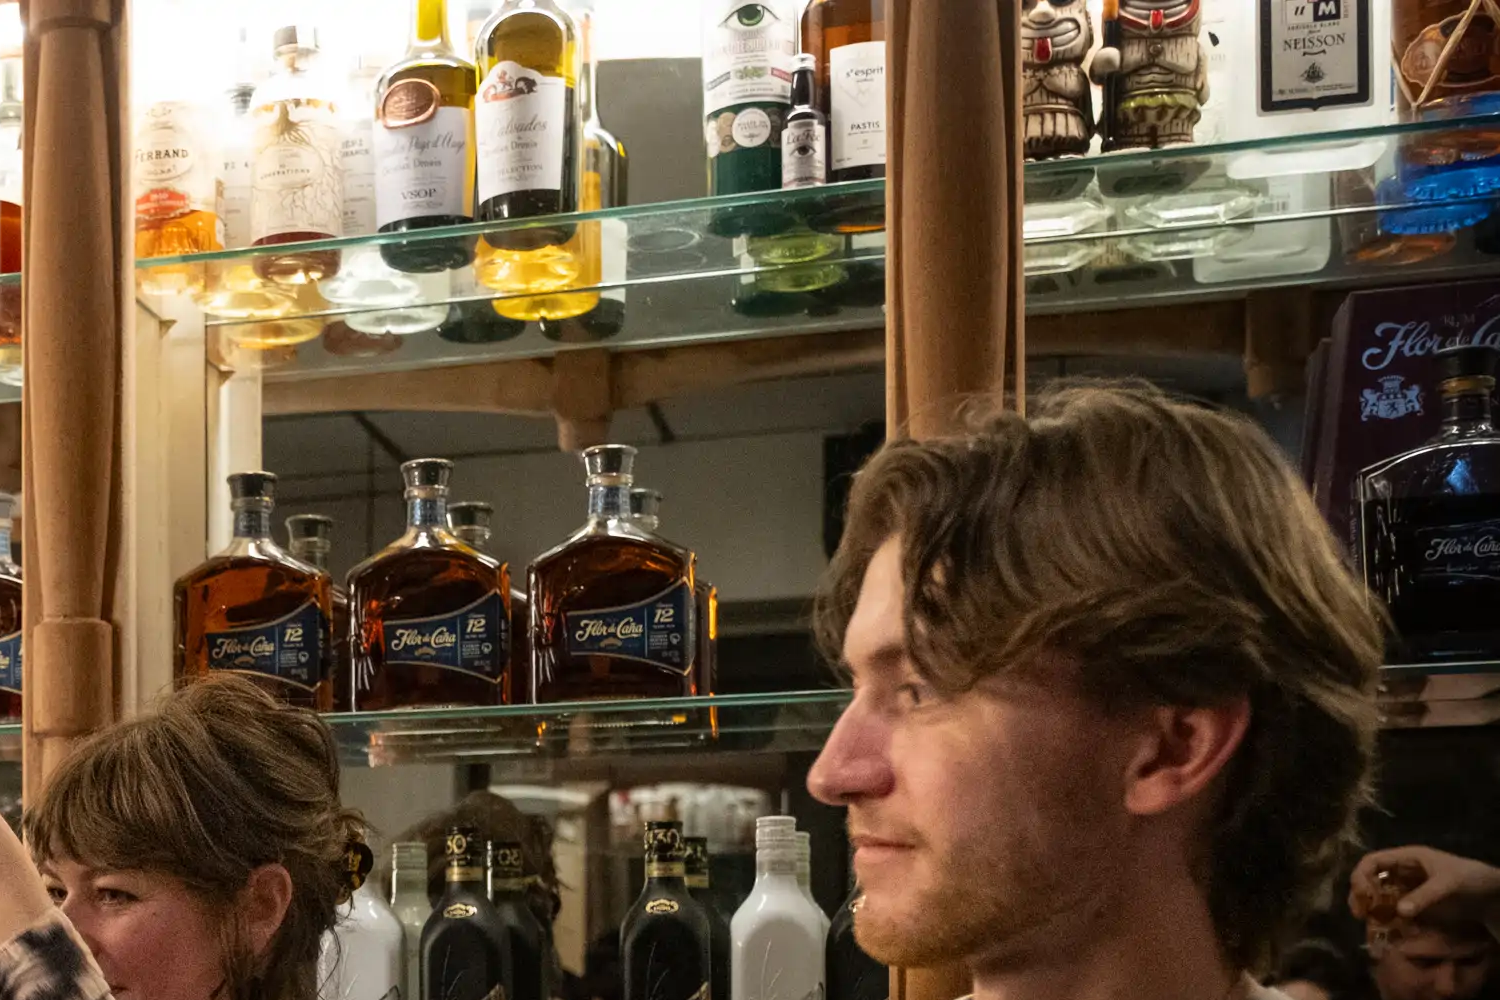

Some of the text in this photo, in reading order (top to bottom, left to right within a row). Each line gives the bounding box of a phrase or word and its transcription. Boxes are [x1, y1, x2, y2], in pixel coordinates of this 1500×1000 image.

[1283, 33, 1347, 52] NEISSON
[850, 121, 881, 131] PASTIS
[401, 187, 438, 201] VSOP
[1361, 321, 1443, 371] Flor
[1424, 537, 1462, 561] Flor
[653, 608, 675, 624] 12
[466, 618, 486, 634] 12
[575, 619, 607, 642] Flor
[616, 616, 644, 639] Caña
[283, 627, 303, 643] 12
[391, 628, 421, 651] Flor
[430, 626, 456, 648] Caña
